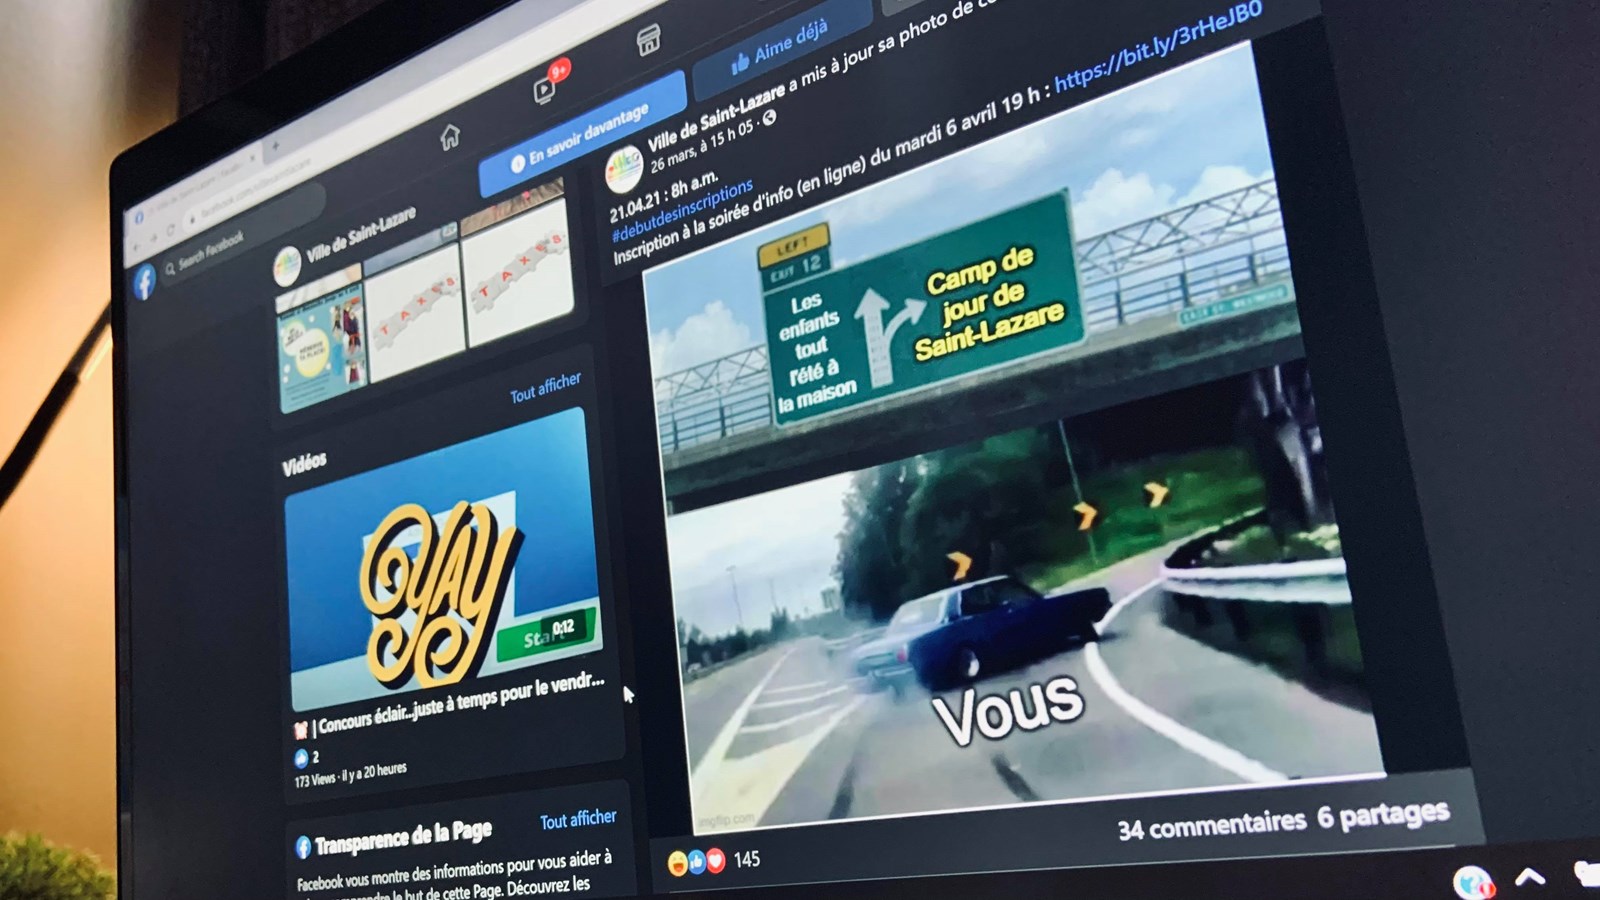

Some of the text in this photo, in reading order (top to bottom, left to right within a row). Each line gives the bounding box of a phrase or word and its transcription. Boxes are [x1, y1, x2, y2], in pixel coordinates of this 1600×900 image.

[755, 20, 828, 64] Aime déjà
[549, 65, 567, 80] 9+
[648, 0, 974, 153] Ville de Saint-Lazare a mis à jour sa photo de
[529, 102, 649, 165] En savoir davantage
[651, 120, 754, 174] 26 mars, à 15 h 05
[613, 229, 680, 265] Inscription
[682, 224, 691, 239] à
[694, 217, 705, 235] la
[709, 201, 750, 229] soirée
[752, 186, 794, 212] d'info
[797, 172, 822, 199] (en
[823, 154, 867, 185] ligne)
[869, 145, 892, 166] du
[894, 124, 942, 157] mardi
[946, 118, 957, 136] 6
[961, 105, 997, 132] avril
[1001, 93, 1023, 115] 19
[1028, 85, 1040, 103] h
[609, 190, 661, 224] 21.04.21
[670, 179, 689, 198] 8h
[691, 170, 719, 191] a.m.
[611, 177, 754, 244] #debutdesinscriptions
[178, 230, 245, 272] Search Facebook
[307, 243, 330, 264] Ville
[333, 235, 347, 252] de
[349, 206, 417, 245] Saint-Lazare
[803, 254, 822, 273] 12
[927, 247, 1034, 296] Camp de
[791, 293, 823, 314] Les
[943, 282, 1025, 329] jour de
[779, 310, 840, 342] enfants
[915, 303, 1065, 362] Saint-Lazare
[794, 336, 829, 361] tout
[828, 359, 840, 376] à
[510, 370, 582, 404] Tout afficher
[778, 380, 857, 414] la maison
[282, 452, 327, 477] Vidéos
[552, 618, 575, 635] 0:12
[319, 713, 373, 735] Concours
[446, 694, 455, 711] à
[457, 689, 499, 713] temps
[501, 685, 533, 707] pour
[536, 679, 549, 696] le
[550, 671, 605, 694] vendr...
[932, 677, 1084, 747] Vous
[313, 751, 319, 764] 2
[294, 761, 407, 789] 173 Views il y a 20 heures
[541, 809, 617, 831] Tout afficher
[1118, 809, 1307, 842] 34 commentaires
[1317, 800, 1451, 834] 6 partages
[314, 819, 493, 857] Transparence de la Page
[297, 848, 613, 892] Facebook vous montre des informations pour vous aider à
[734, 850, 761, 868] 145
[426, 887, 440, 900] de
[443, 884, 470, 900] cette
[474, 884, 504, 900] Page.
[507, 880, 570, 896] Découvrez
[573, 875, 591, 891] les
